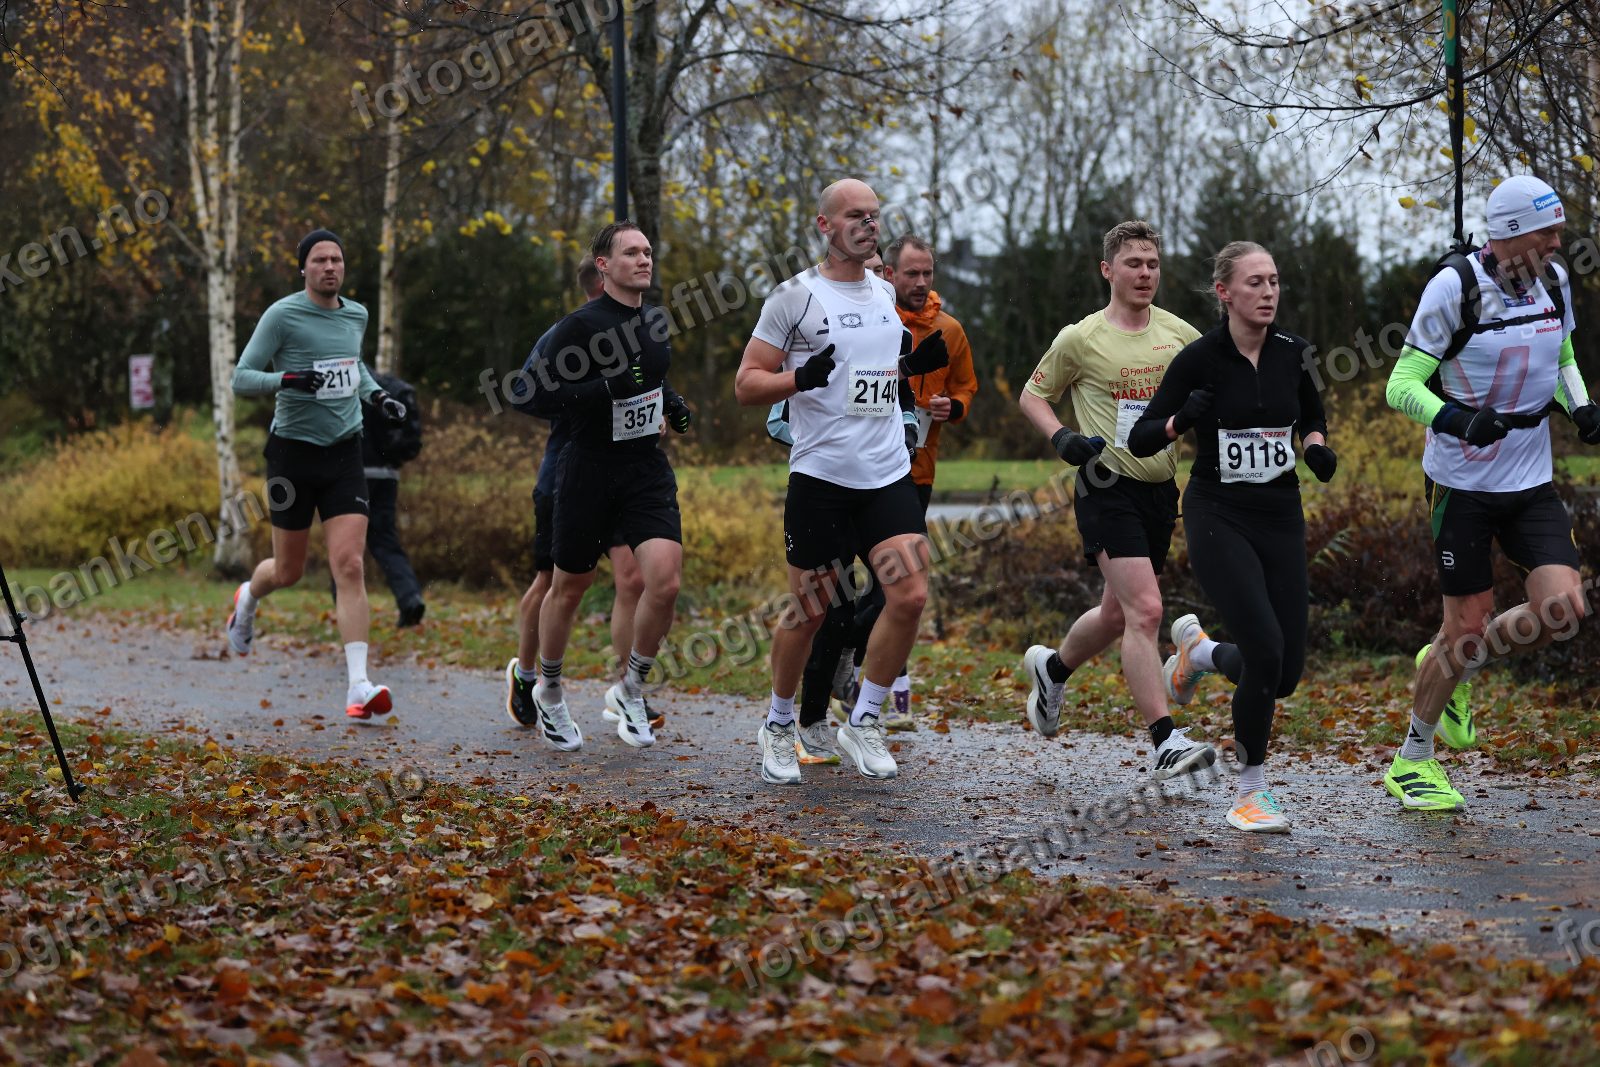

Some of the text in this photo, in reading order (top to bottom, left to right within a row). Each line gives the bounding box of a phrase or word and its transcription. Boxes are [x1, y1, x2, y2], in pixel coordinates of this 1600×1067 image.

[326, 367, 352, 389] 211
[1130, 364, 1165, 377] Fjordkraft
[1108, 377, 1151, 390] BERGEN
[624, 402, 657, 430] 357
[1225, 430, 1288, 440] NORGESTESTEN
[1227, 440, 1288, 470] 9118
